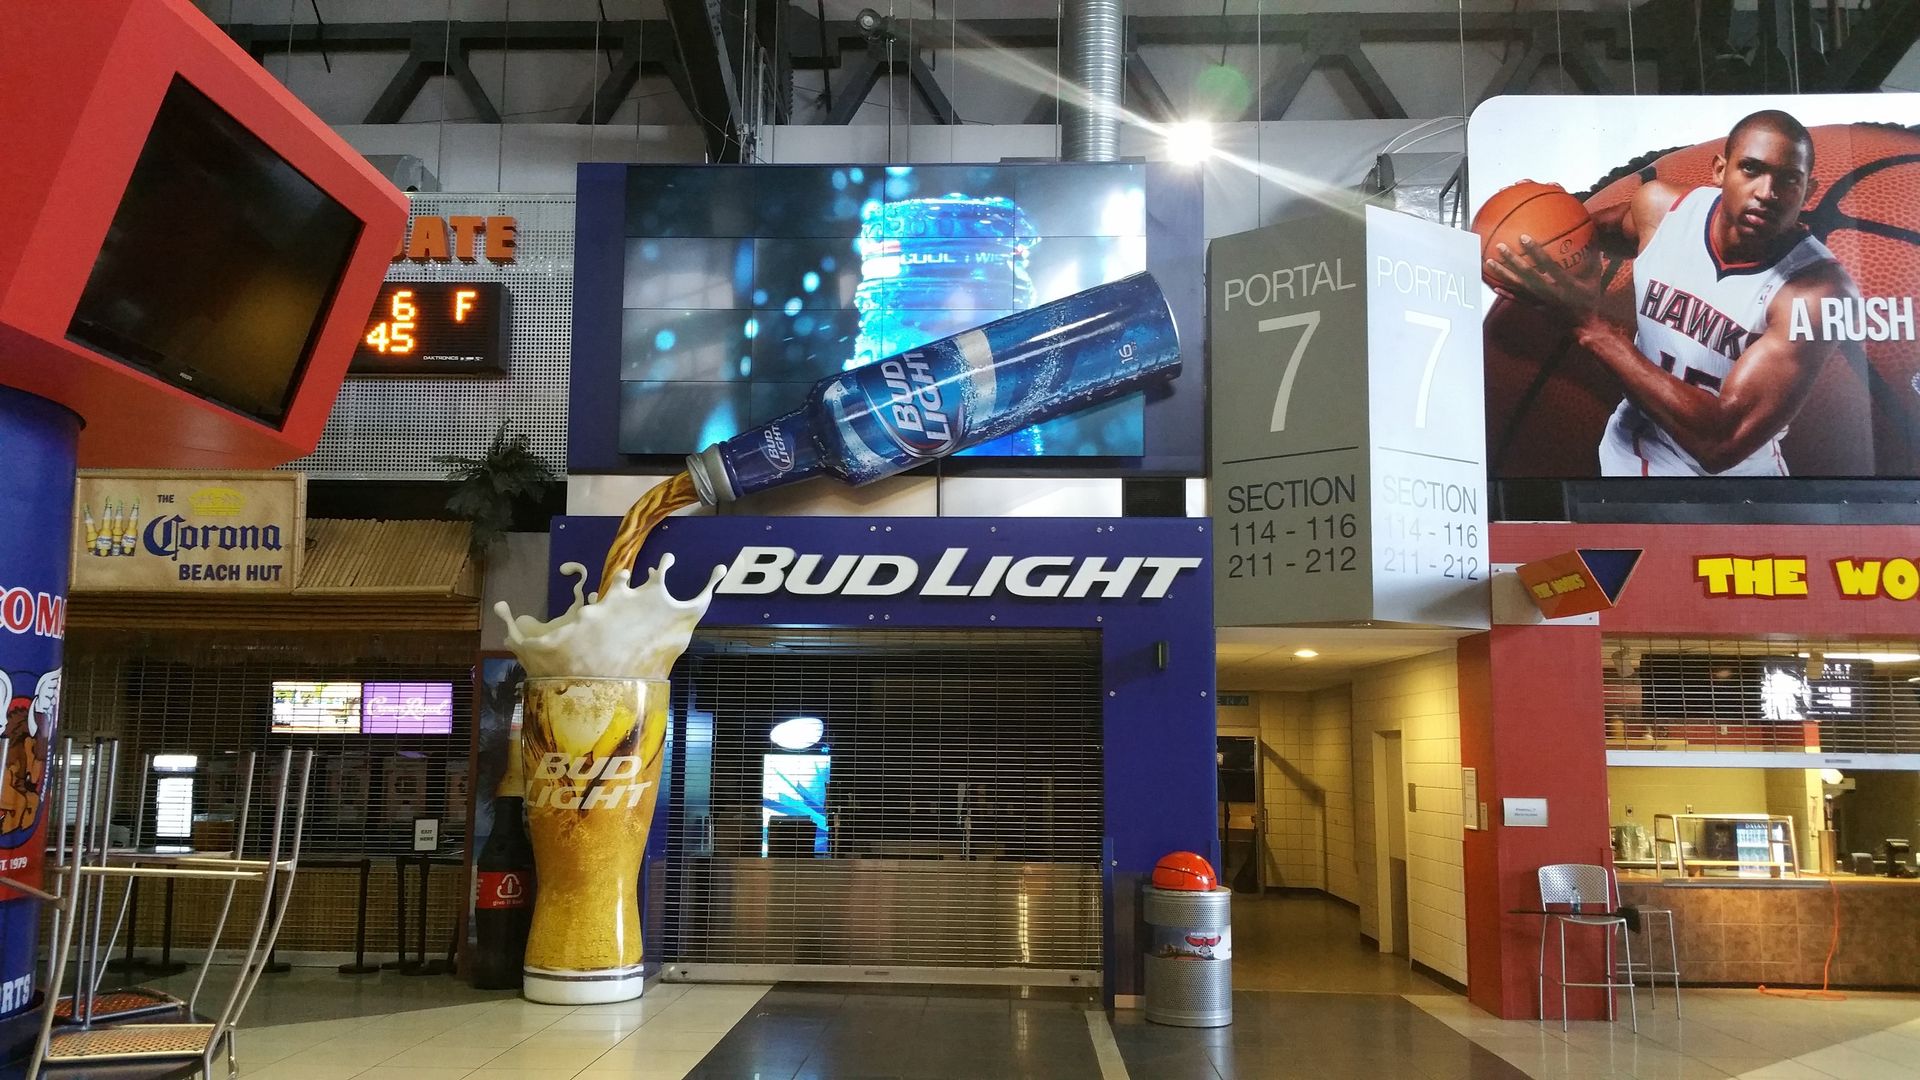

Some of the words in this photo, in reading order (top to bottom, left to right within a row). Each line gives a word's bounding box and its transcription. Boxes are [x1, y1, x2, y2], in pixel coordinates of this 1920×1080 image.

[390, 216, 517, 265] ATE
[1224, 258, 1356, 312] PORTAL
[1377, 255, 1474, 310] PORTAL
[392, 291, 416, 321] 6
[456, 291, 476, 321] F
[1789, 297, 1815, 341] A
[1821, 296, 1916, 341] RUSH
[366, 322, 415, 352] 45
[1118, 344, 1133, 364] 16
[1258, 310, 1321, 433] 7
[1404, 310, 1451, 429] 7
[880, 360, 924, 432] BUD
[902, 352, 952, 441] LIGHT
[763, 429, 781, 459] BUD
[771, 424, 792, 464] LIGHT
[156, 494, 175, 504] THE
[1227, 474, 1356, 514] SECTION
[1382, 474, 1477, 516] SECTION
[142, 514, 283, 562] Corona
[1229, 520, 1276, 546] 114
[1307, 513, 1357, 541] 116
[1384, 514, 1422, 541] 114
[1443, 520, 1478, 549] 116
[178, 564, 241, 581] BEACH
[246, 564, 283, 581] HUT
[714, 545, 919, 596] BUD
[919, 547, 1203, 599] LIGHT
[1228, 551, 1273, 578] 211
[1305, 546, 1357, 574] 212
[1383, 546, 1420, 575] 211
[1443, 553, 1479, 581] 212
[1698, 557, 1809, 597] THE
[1531, 582, 1555, 599] THE
[0, 586, 67, 640] OM
[534, 752, 643, 780] BUD
[10, 856, 28, 870] 1979
[0, 973, 31, 1014] RTS
